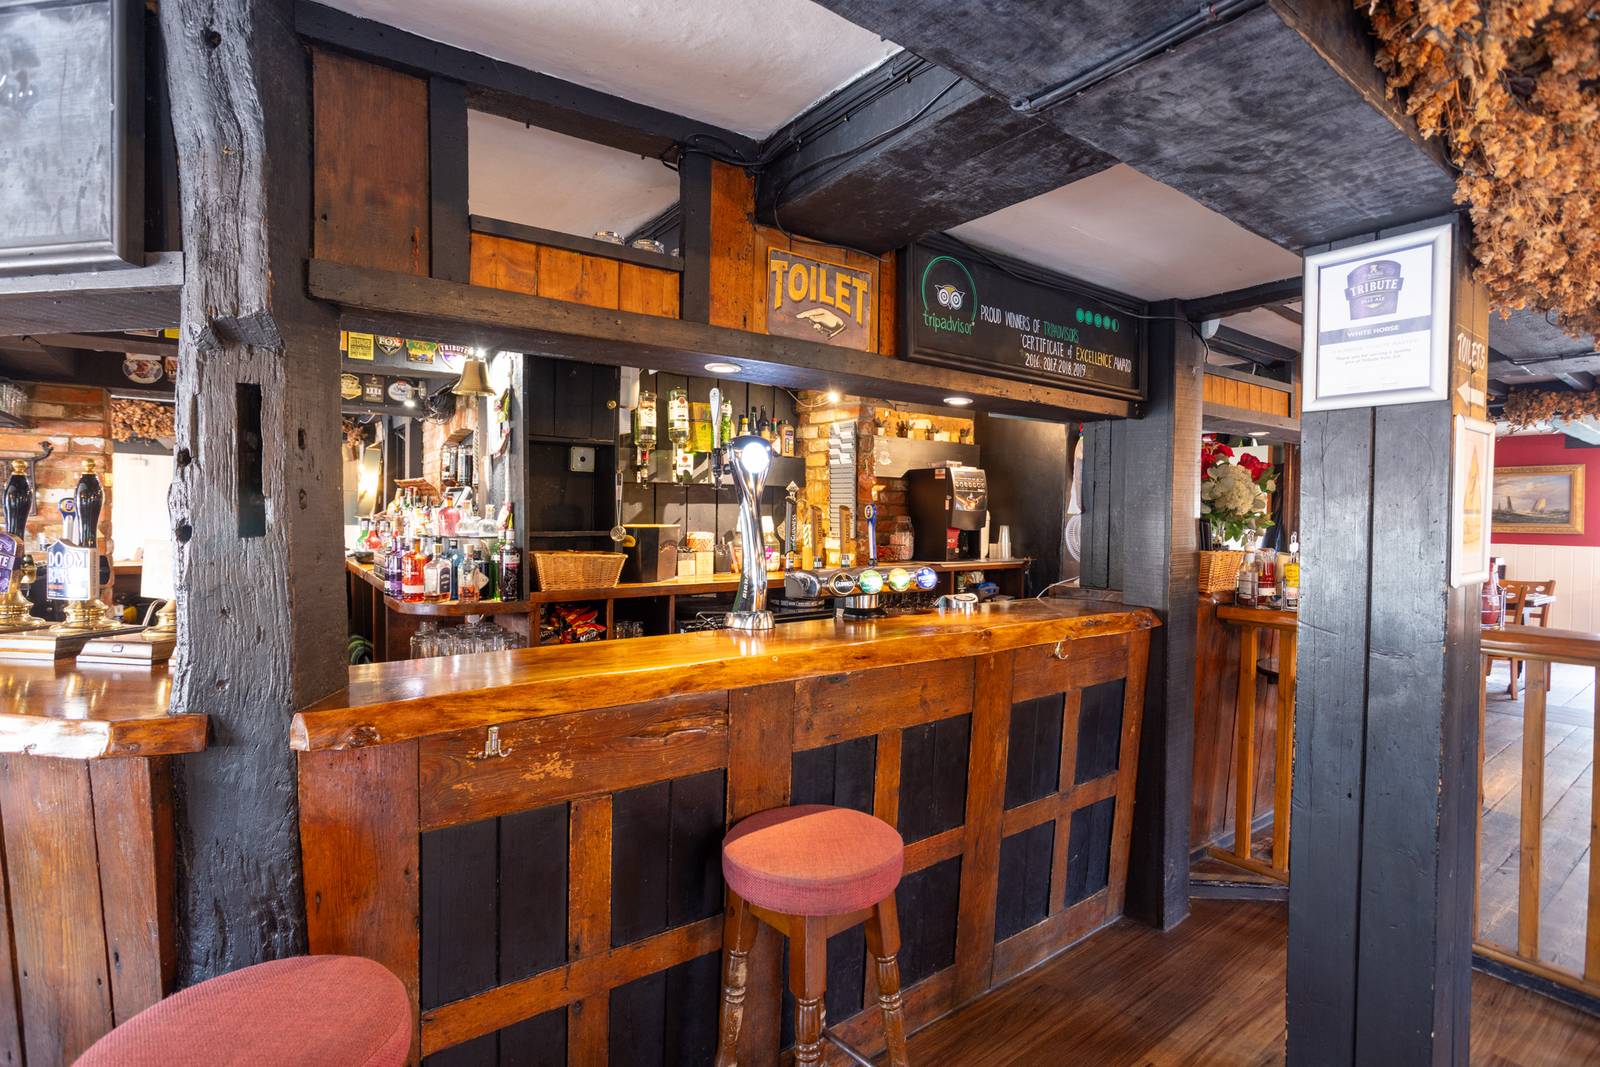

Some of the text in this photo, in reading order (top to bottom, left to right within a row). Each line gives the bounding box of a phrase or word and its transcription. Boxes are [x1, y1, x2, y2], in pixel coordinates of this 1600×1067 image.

[770, 259, 868, 328] TOILET
[1350, 279, 1399, 297] TRIBUTE
[923, 311, 974, 335] tripadvisor
[980, 304, 1001, 325] PROUD
[1005, 310, 1030, 332] WINNERS
[1033, 319, 1041, 334] OF
[1347, 325, 1399, 338] WHITE HORSE
[1457, 332, 1485, 371] TOILETS
[1113, 356, 1131, 374] AWARD
[48, 551, 87, 568] DOOM
[48, 568, 72, 584] BAR
